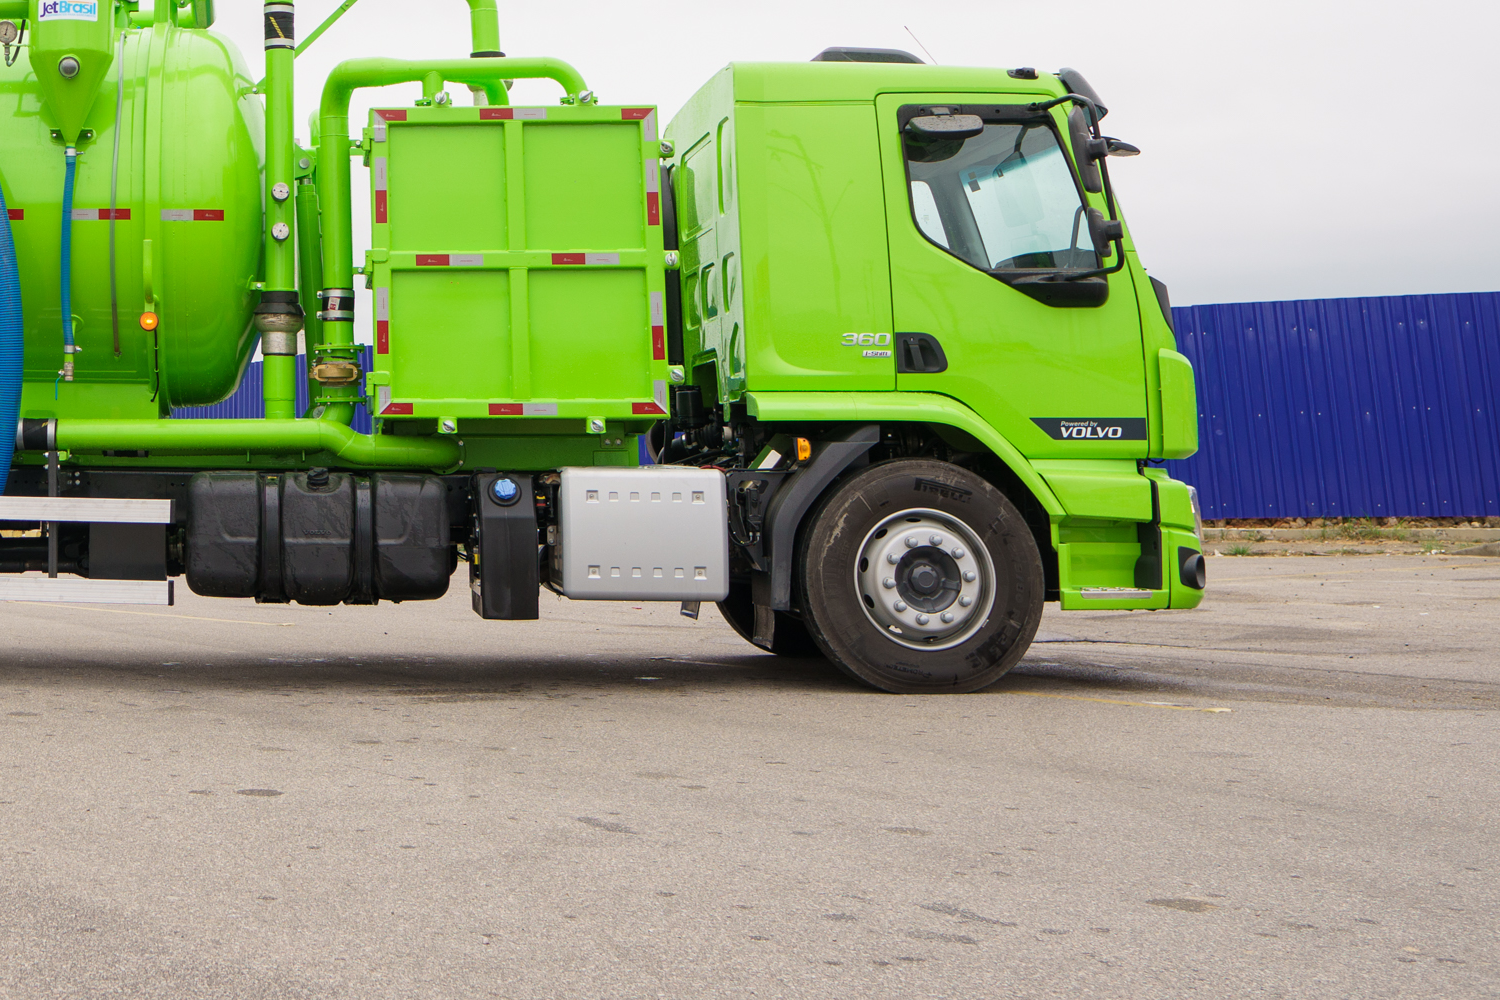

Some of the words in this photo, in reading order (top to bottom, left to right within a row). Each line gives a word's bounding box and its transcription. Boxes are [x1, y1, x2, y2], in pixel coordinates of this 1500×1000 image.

[40, 0, 97, 18] JetBrasil
[841, 332, 891, 347] 360
[1089, 420, 1099, 428] by
[1060, 426, 1123, 439] VOLVO
